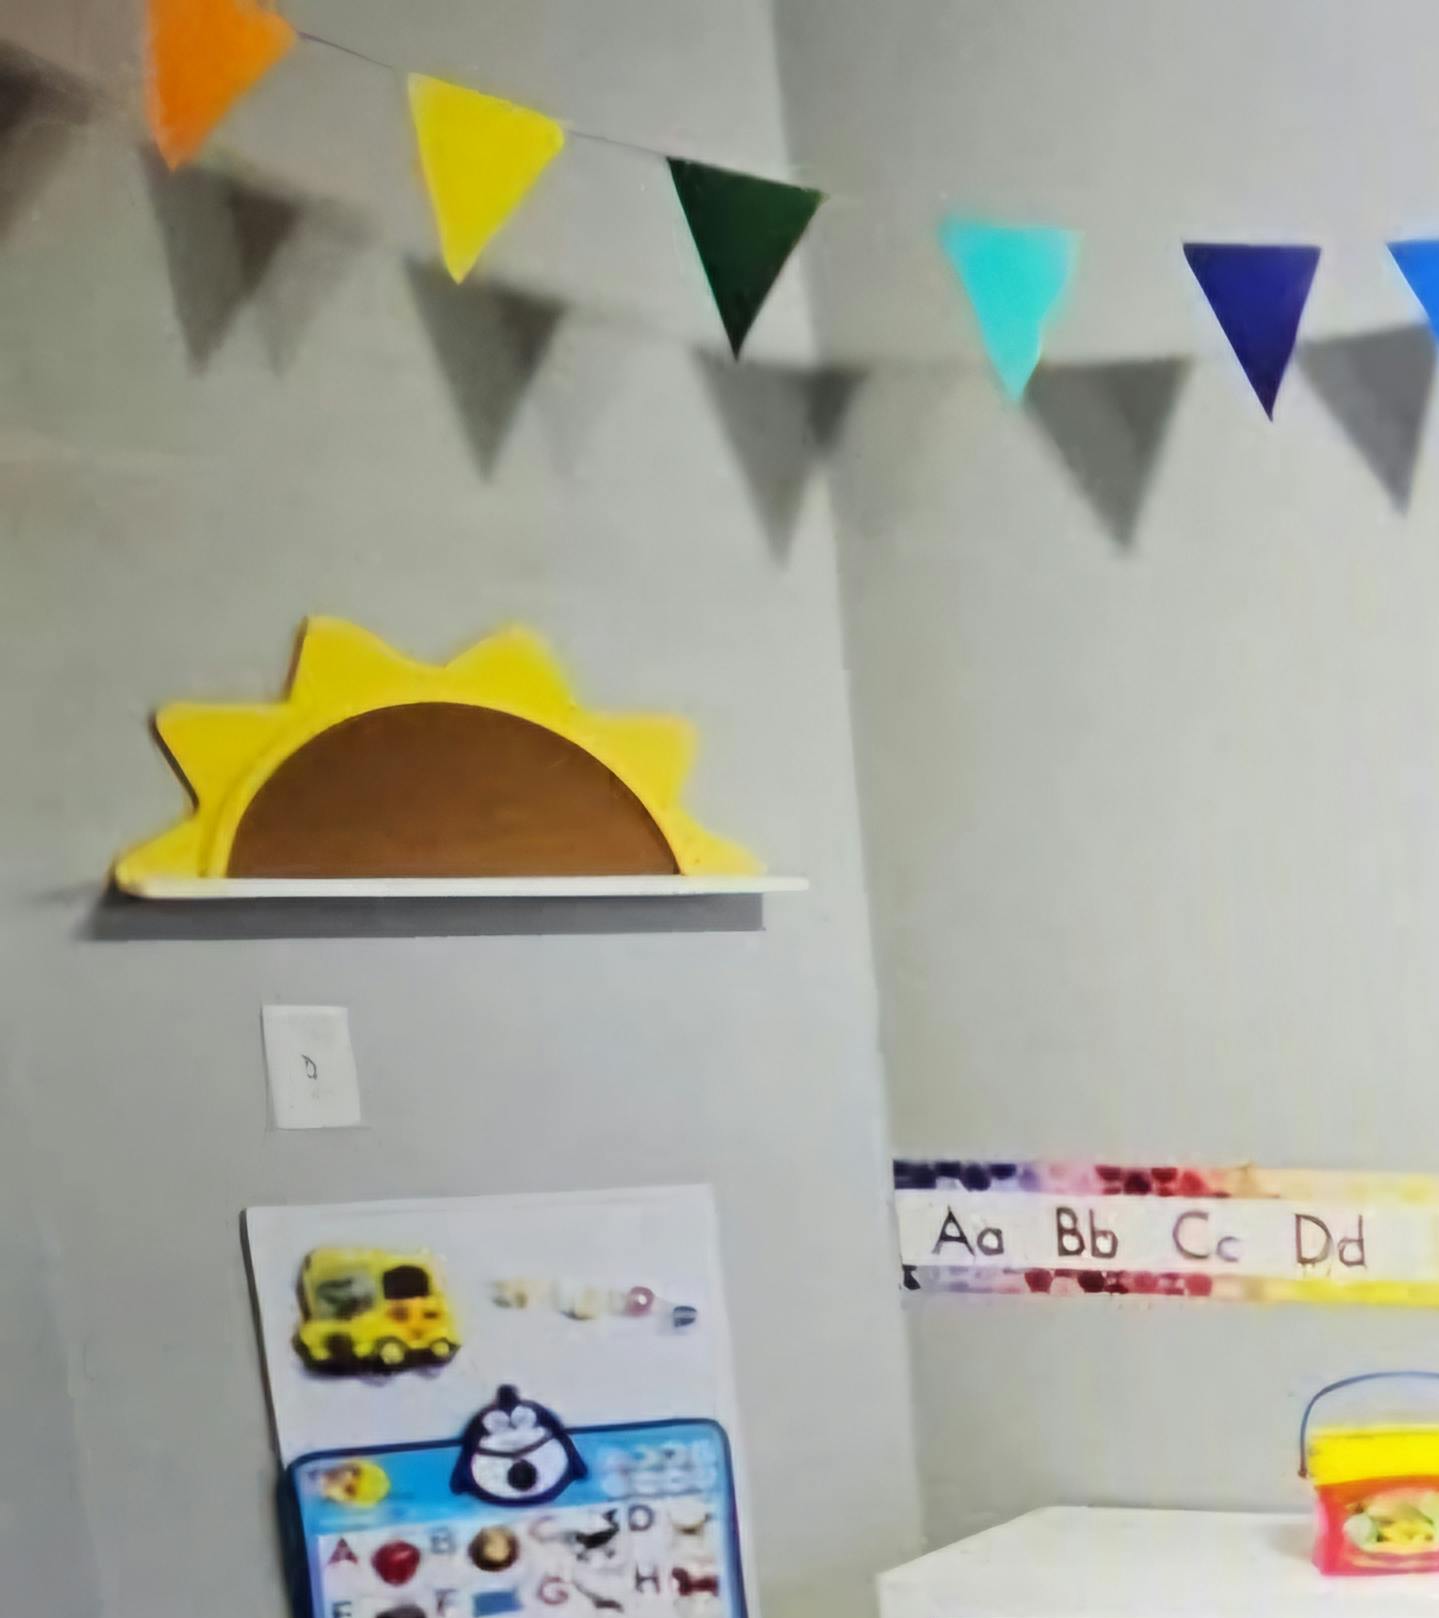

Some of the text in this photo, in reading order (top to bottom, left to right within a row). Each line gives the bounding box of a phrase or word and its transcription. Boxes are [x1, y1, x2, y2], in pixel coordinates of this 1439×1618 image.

[931, 1205, 1004, 1257] Aa
[1054, 1206, 1119, 1260] Bb
[1172, 1210, 1243, 1263] Cc
[1294, 1212, 1368, 1268] Dd
[537, 1575, 570, 1606] G
[634, 1562, 662, 1595] H
